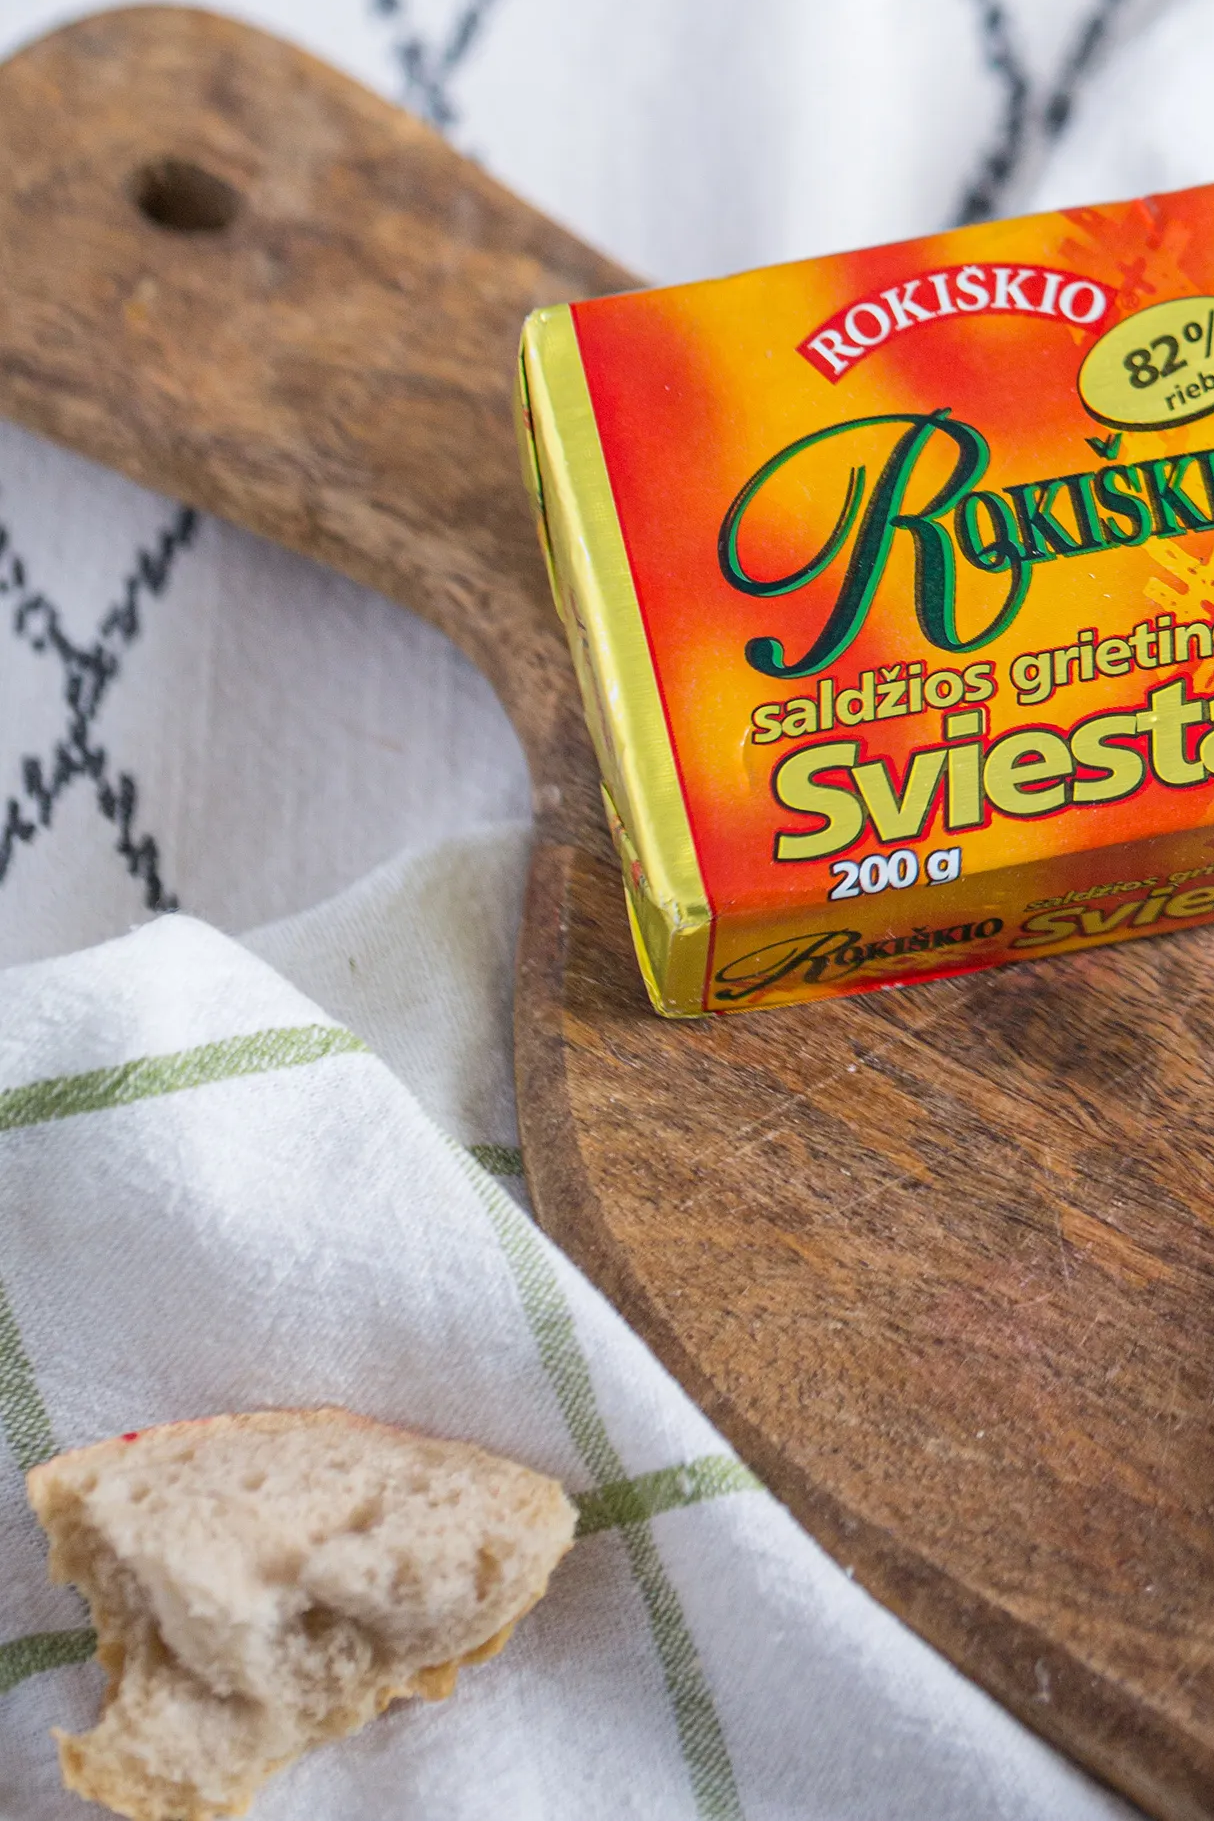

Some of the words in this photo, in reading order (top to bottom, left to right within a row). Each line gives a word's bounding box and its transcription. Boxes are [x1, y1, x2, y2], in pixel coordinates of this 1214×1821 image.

[807, 266, 1107, 376] ROKIŠKIO
[751, 661, 996, 745] saldžios
[830, 853, 916, 902] 200
[924, 846, 962, 887] g
